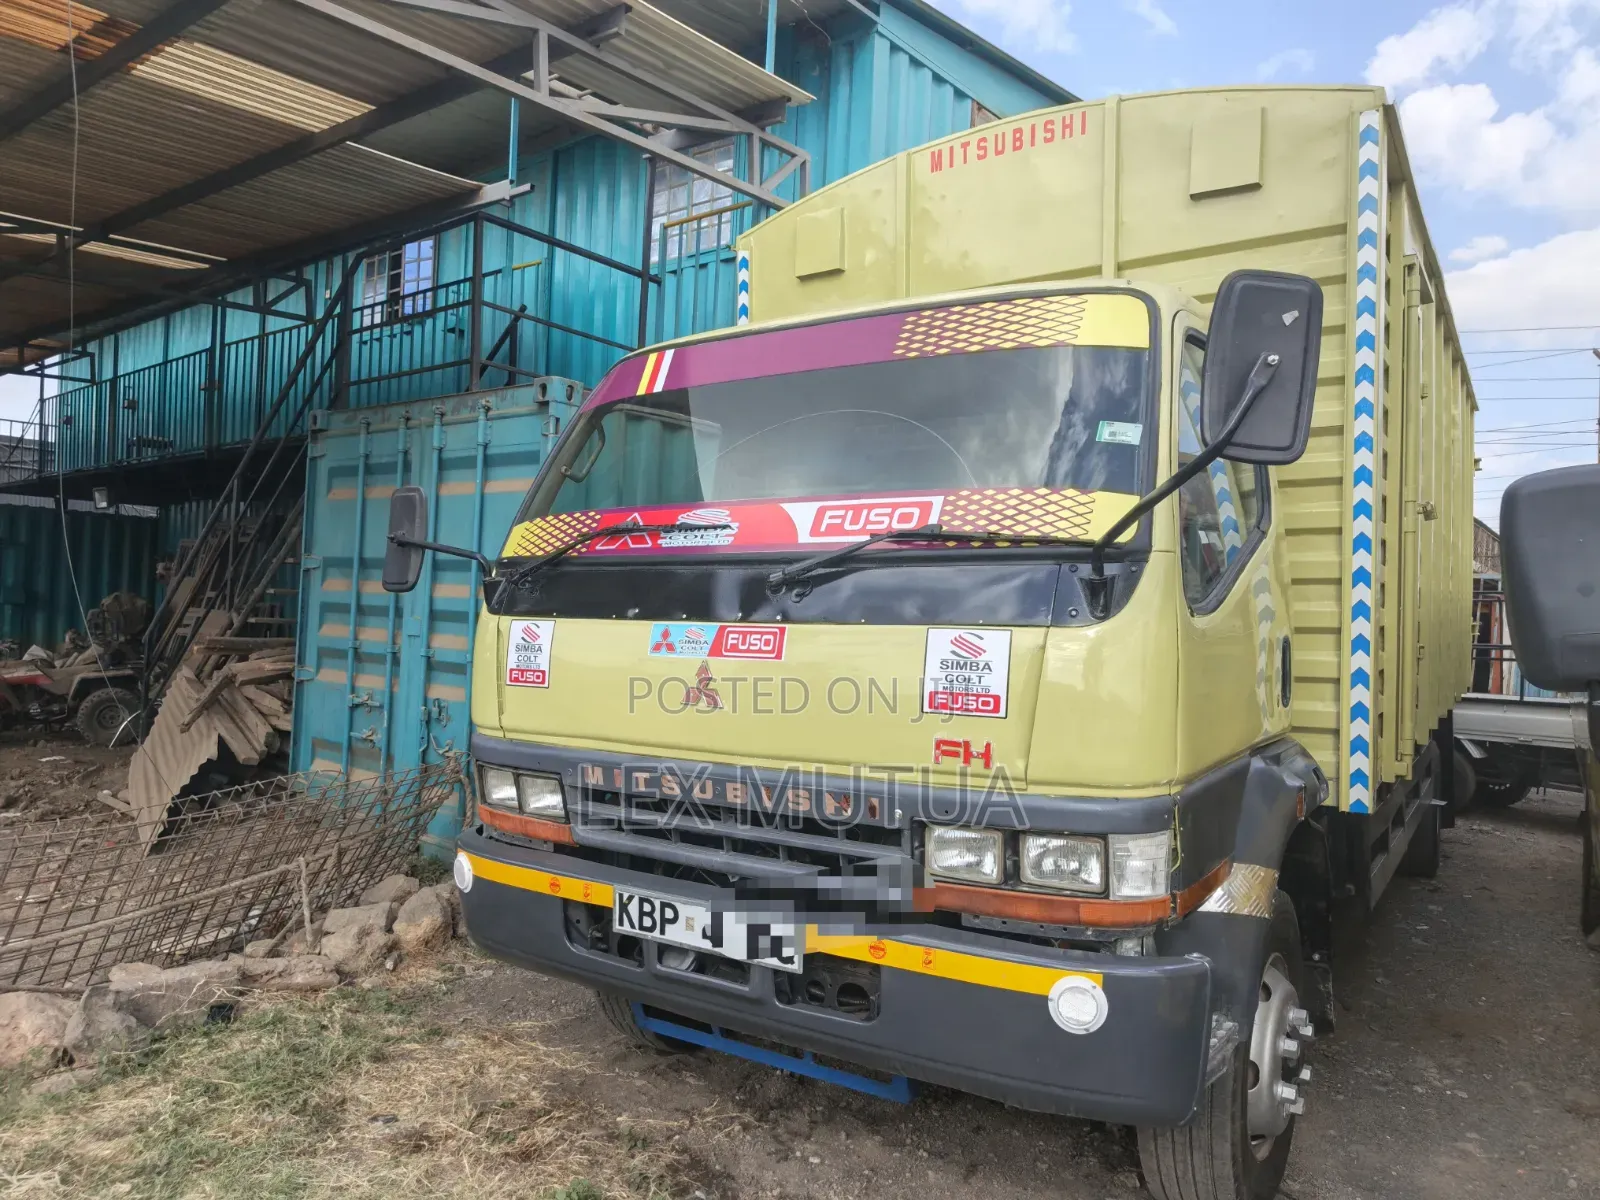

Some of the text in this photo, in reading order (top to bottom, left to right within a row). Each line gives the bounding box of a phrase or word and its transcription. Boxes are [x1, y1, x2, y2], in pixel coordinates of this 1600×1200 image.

[930, 110, 1087, 173] MITSUBISHI
[819, 506, 921, 532] FUSO
[514, 644, 543, 653] SIMBA
[726, 633, 775, 651] FUSO
[516, 654, 539, 663] COLT
[940, 660, 993, 672] SIMBA
[511, 671, 543, 683] FUSO
[944, 673, 986, 684] COLT
[942, 685, 974, 693] MOTORS
[934, 693, 995, 710] FUSO
[933, 737, 992, 769] FH
[583, 765, 880, 820] MITSUBISHI
[617, 892, 680, 936] KBP
